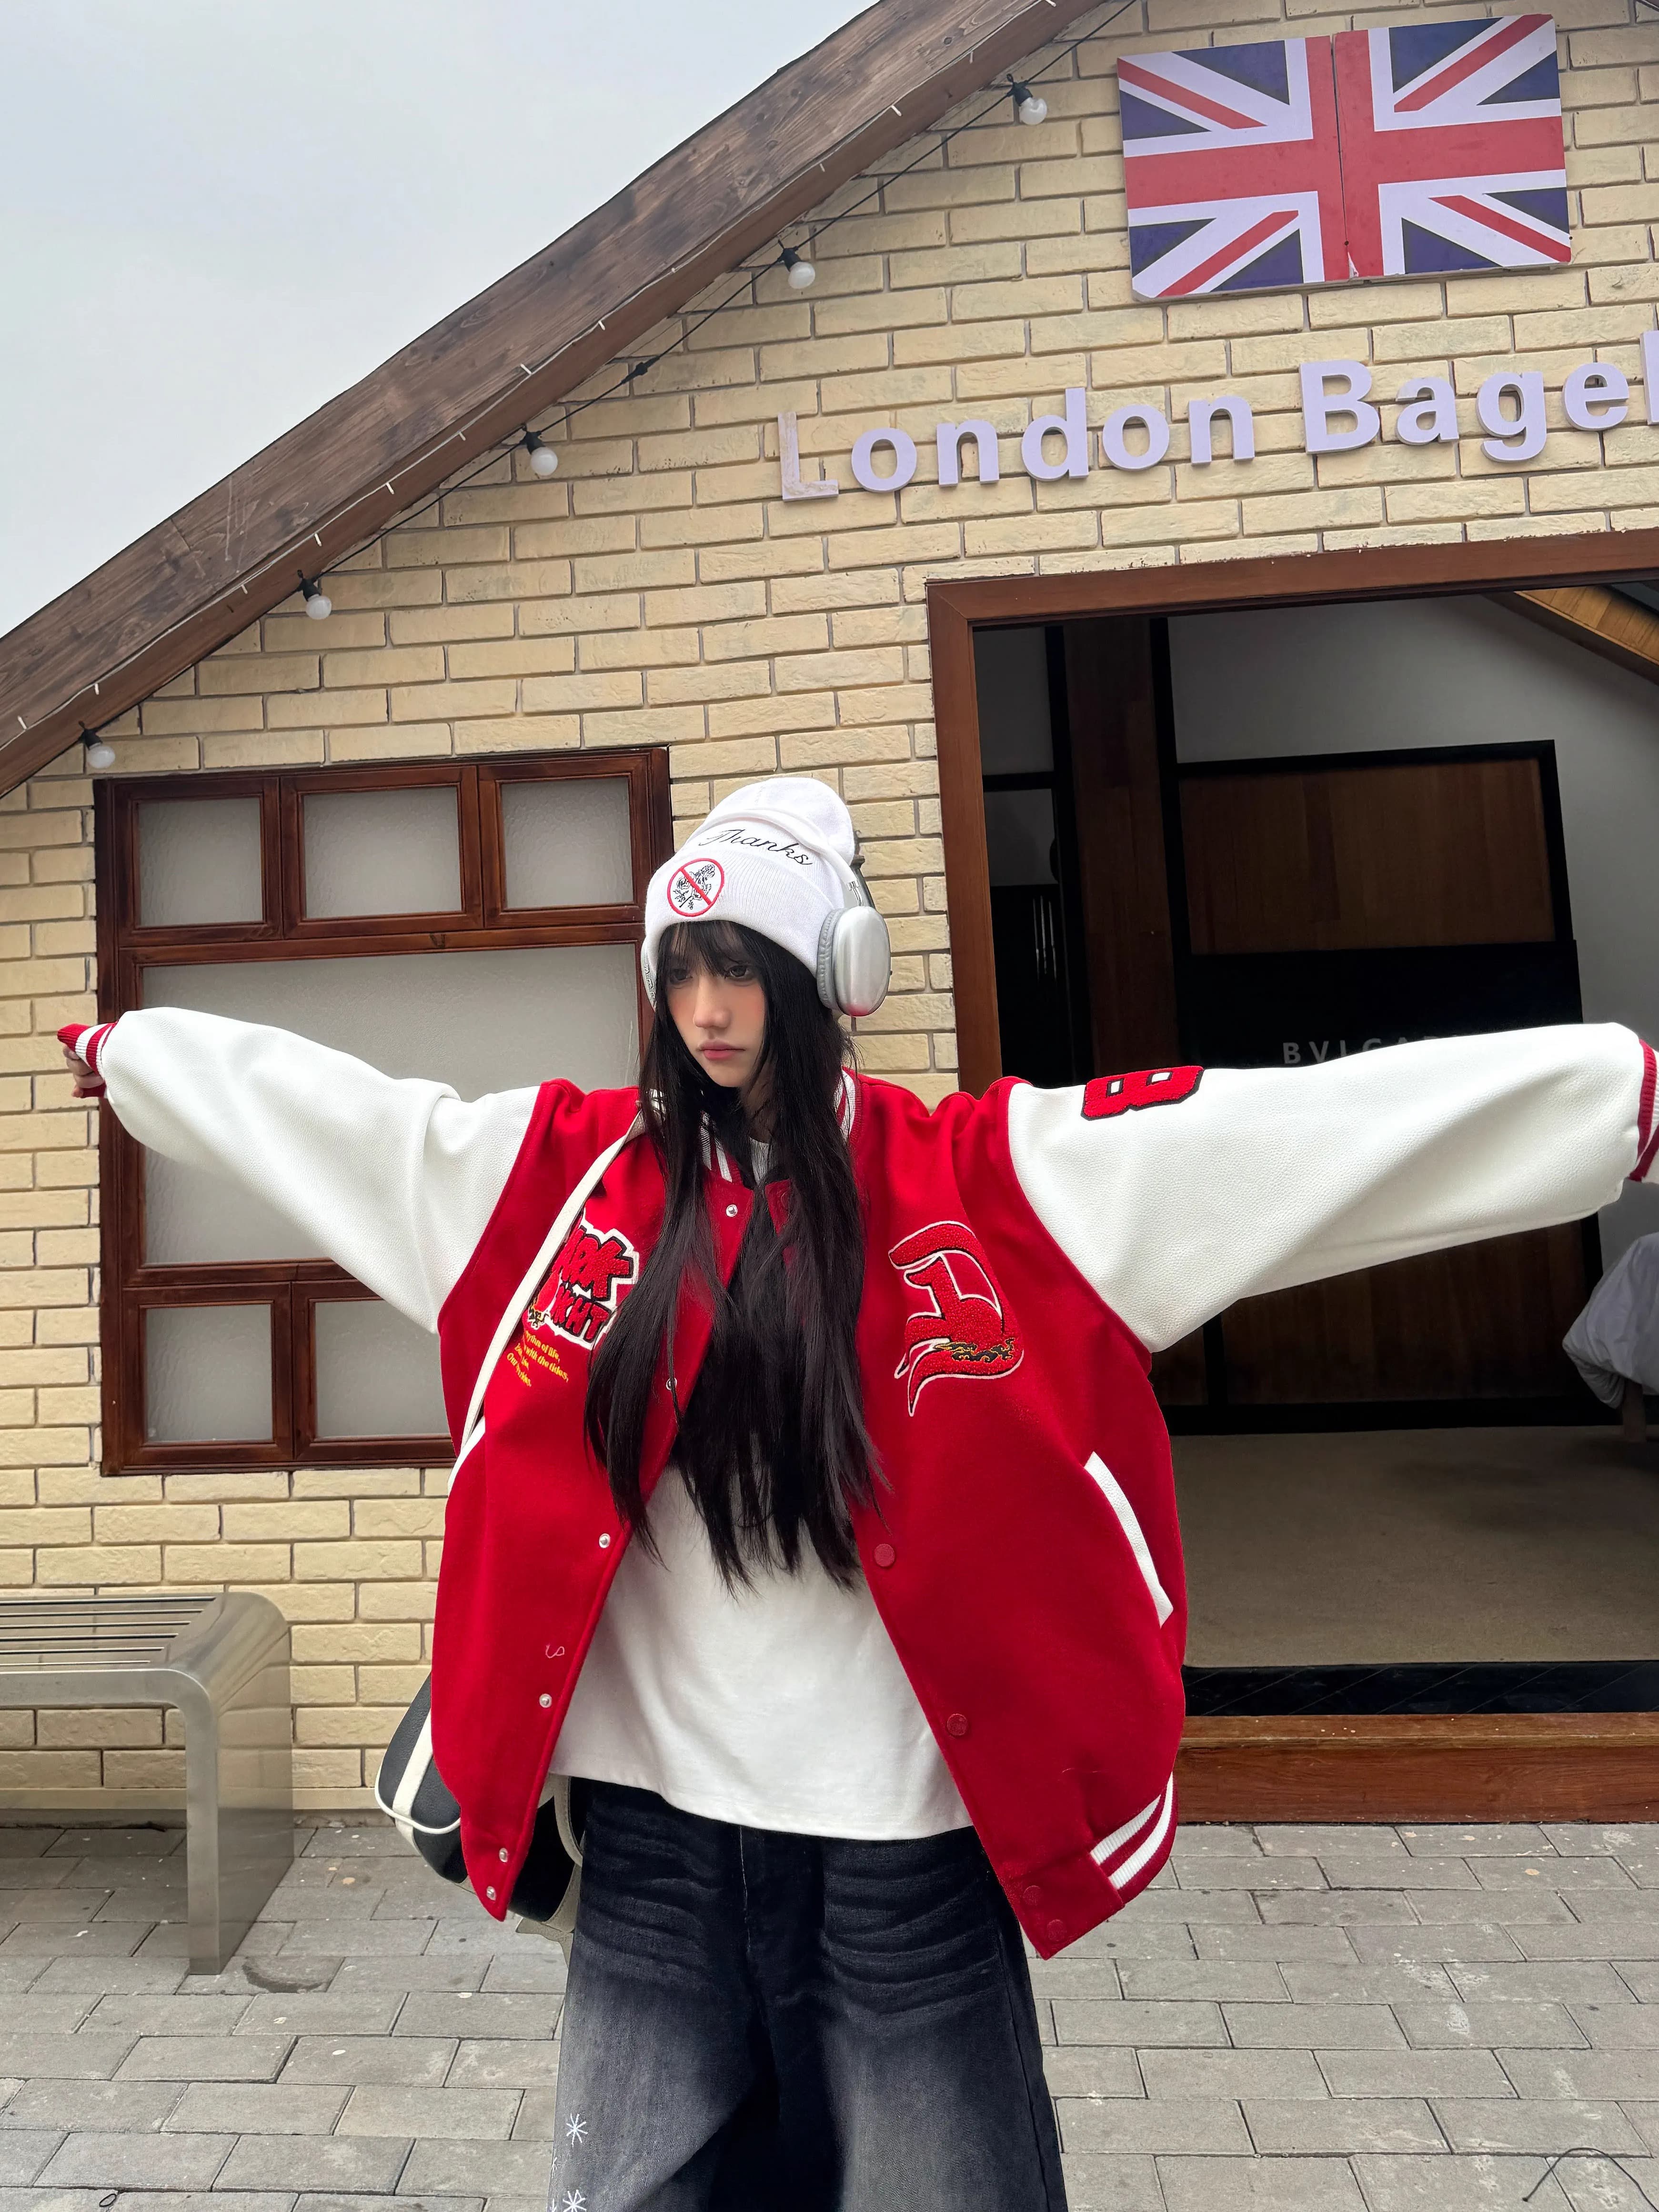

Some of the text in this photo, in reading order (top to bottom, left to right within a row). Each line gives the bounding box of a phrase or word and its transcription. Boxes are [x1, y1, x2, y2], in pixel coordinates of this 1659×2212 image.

[777, 330, 1659, 501] London Bagel
[698, 829, 813, 865] Thanks
[525, 1346, 538, 1361] with
[537, 1355, 549, 1368] the
[541, 1343, 549, 1353] of
